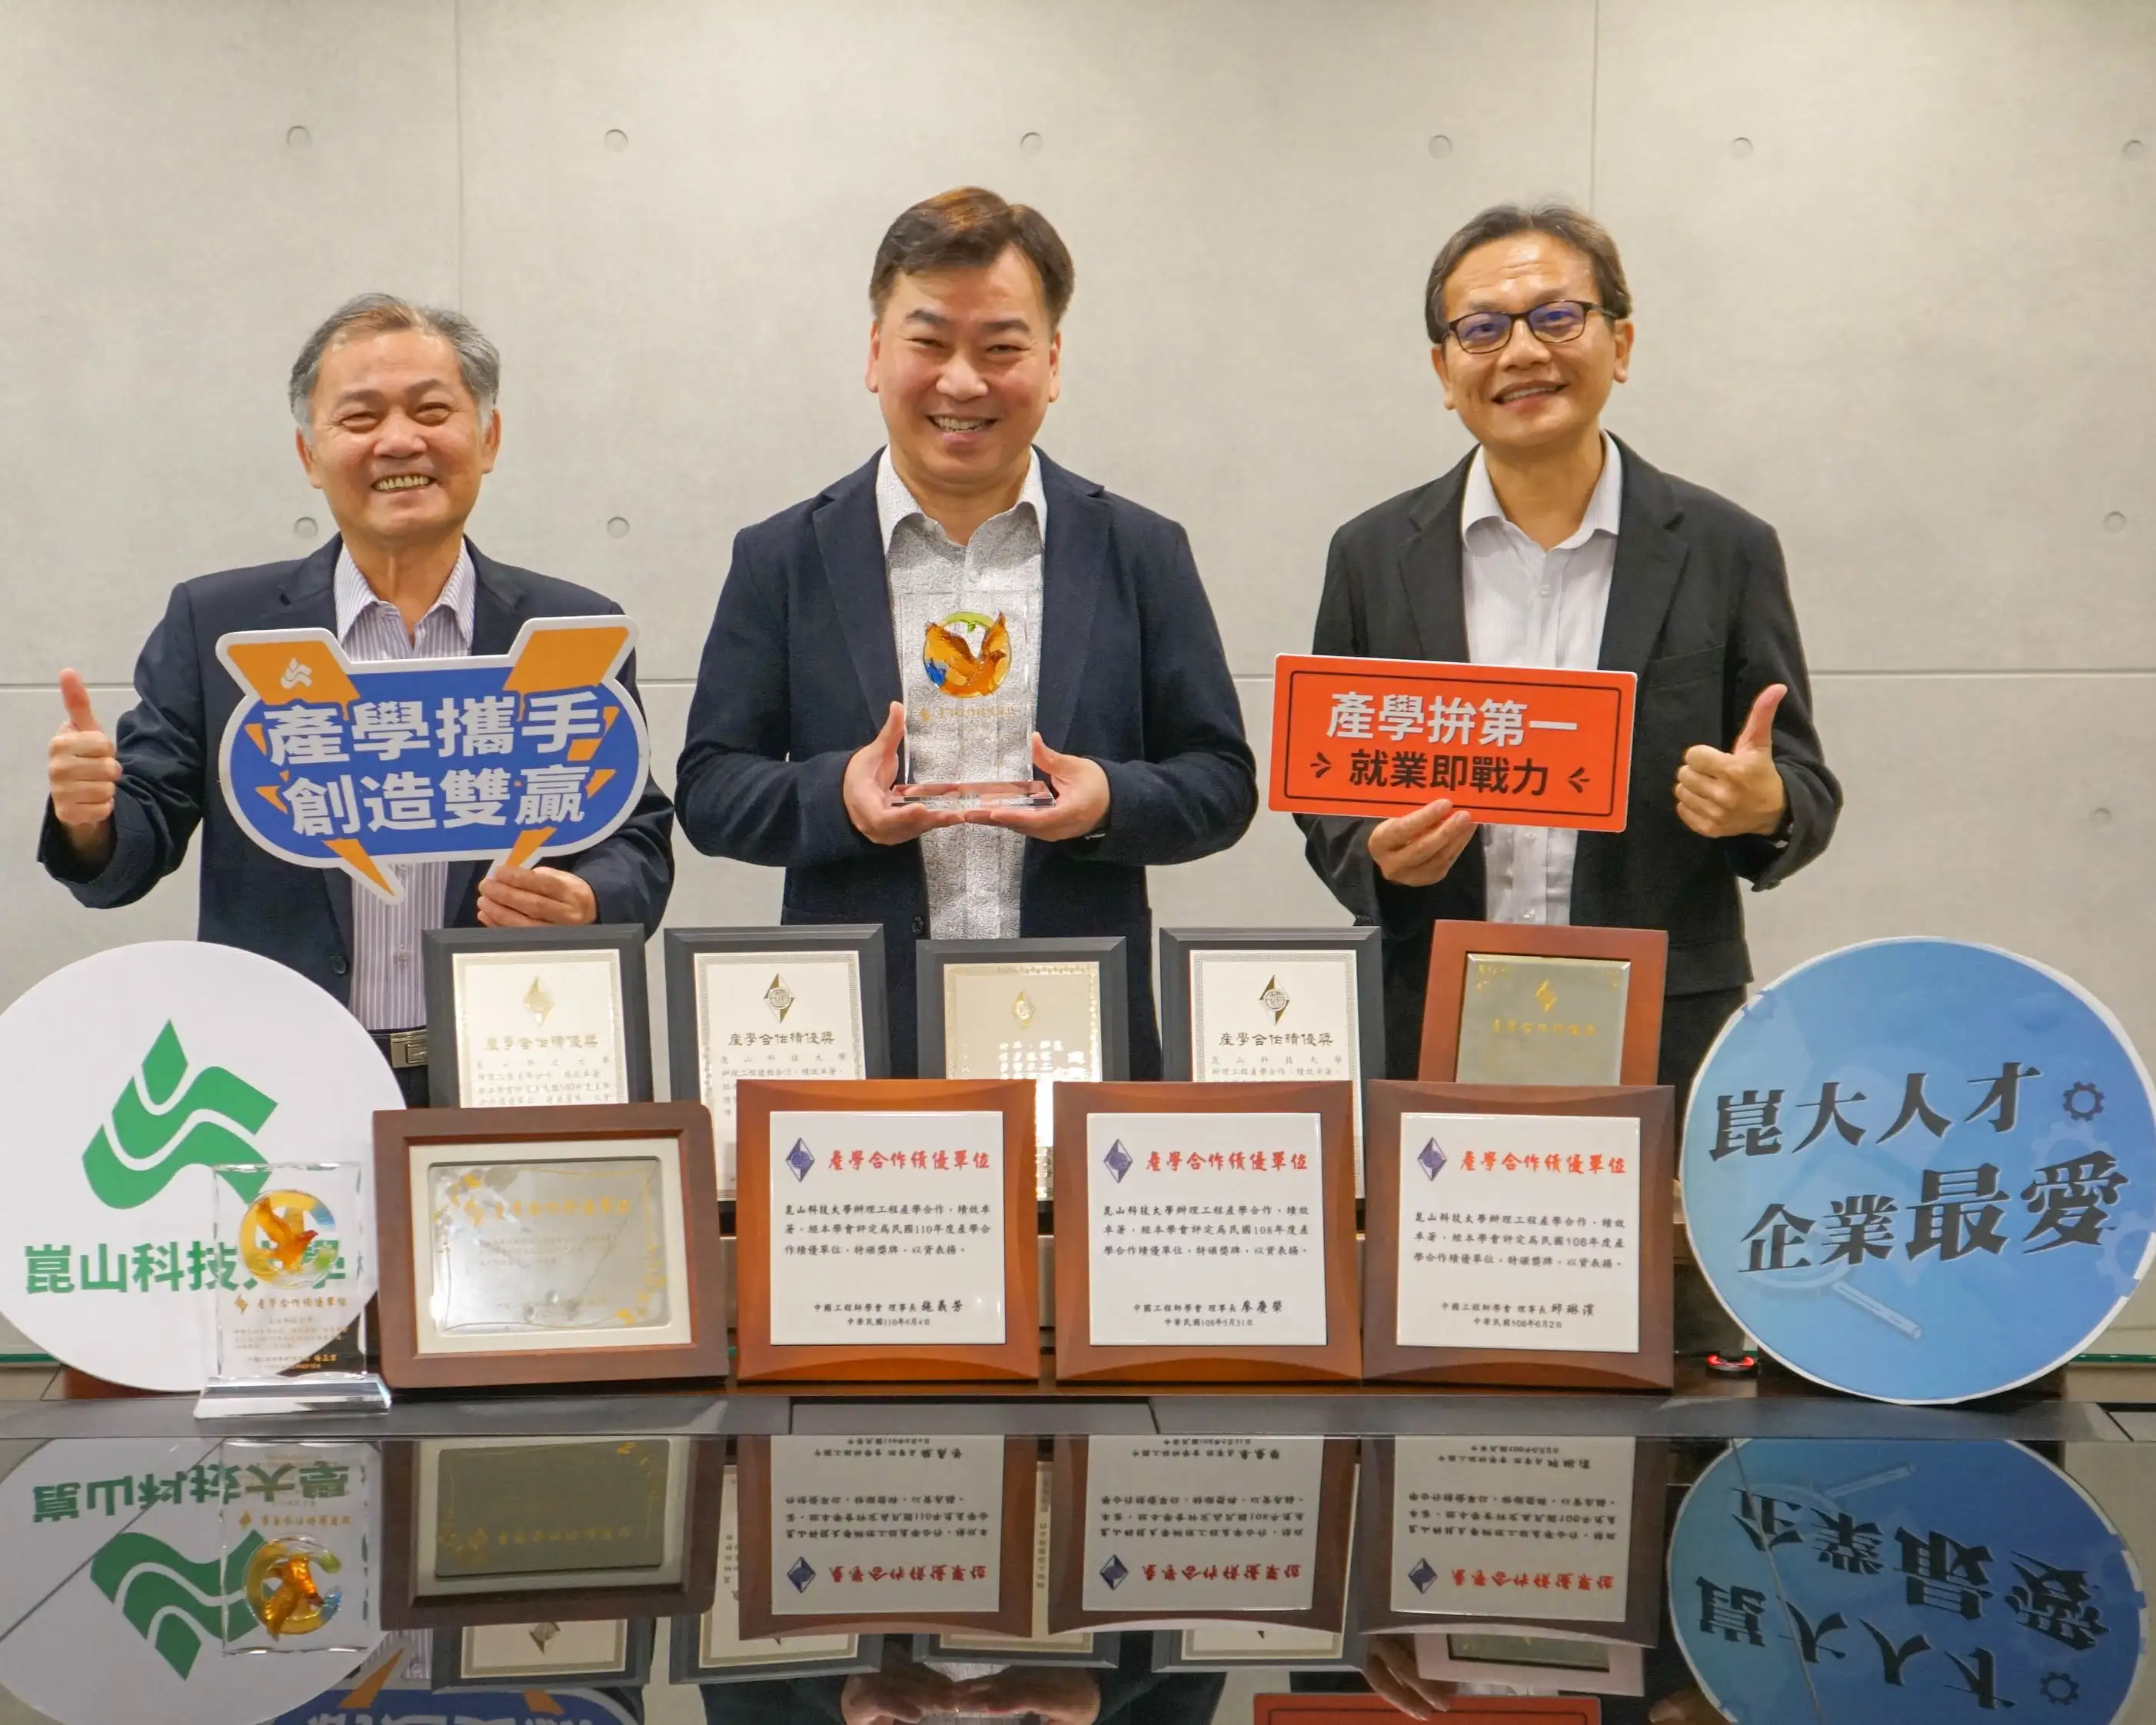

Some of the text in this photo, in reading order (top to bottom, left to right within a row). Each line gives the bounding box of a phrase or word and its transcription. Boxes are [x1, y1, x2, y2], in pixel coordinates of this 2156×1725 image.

[263, 691, 602, 768] 產學攜手
[1326, 691, 1578, 748] 產學拚第一
[1349, 748, 1549, 797] 就業即戰力
[281, 764, 591, 838] 創造雙贏
[1708, 1061, 2042, 1163] 崑大人才
[827, 1149, 991, 1171] 產學合作績優單位
[1146, 1150, 1309, 1172] 產學合作績優單位
[1459, 1150, 1626, 1174] 產學合作績優單位
[1737, 1150, 2131, 1274] 企業最愛
[24, 1239, 347, 1294] 崑山科技學
